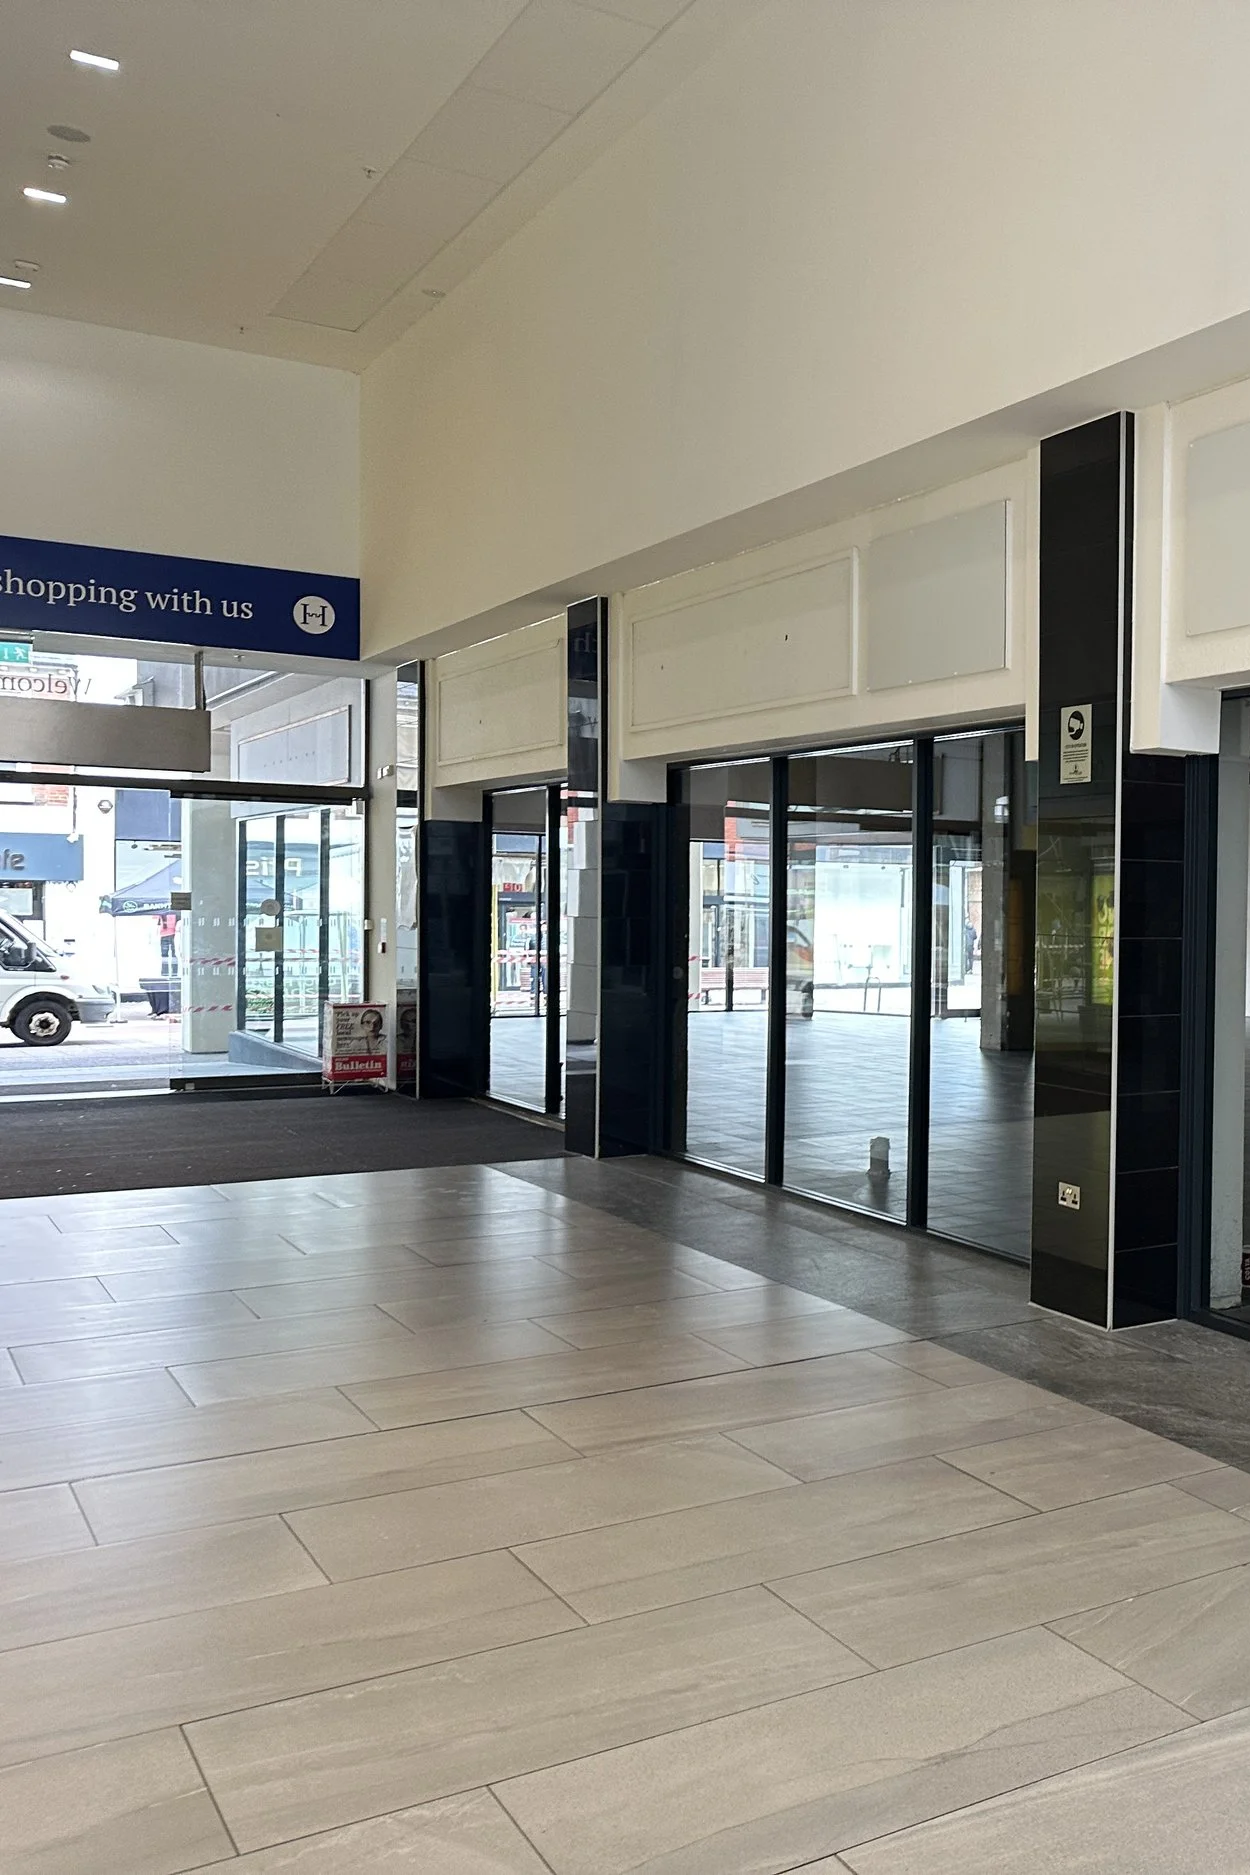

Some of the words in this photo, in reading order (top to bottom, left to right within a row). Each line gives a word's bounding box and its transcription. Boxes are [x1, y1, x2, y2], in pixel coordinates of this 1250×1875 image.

[0, 569, 138, 612] hopping
[146, 588, 212, 616] with
[222, 599, 253, 619] us
[335, 1060, 382, 1071] Bulletin
